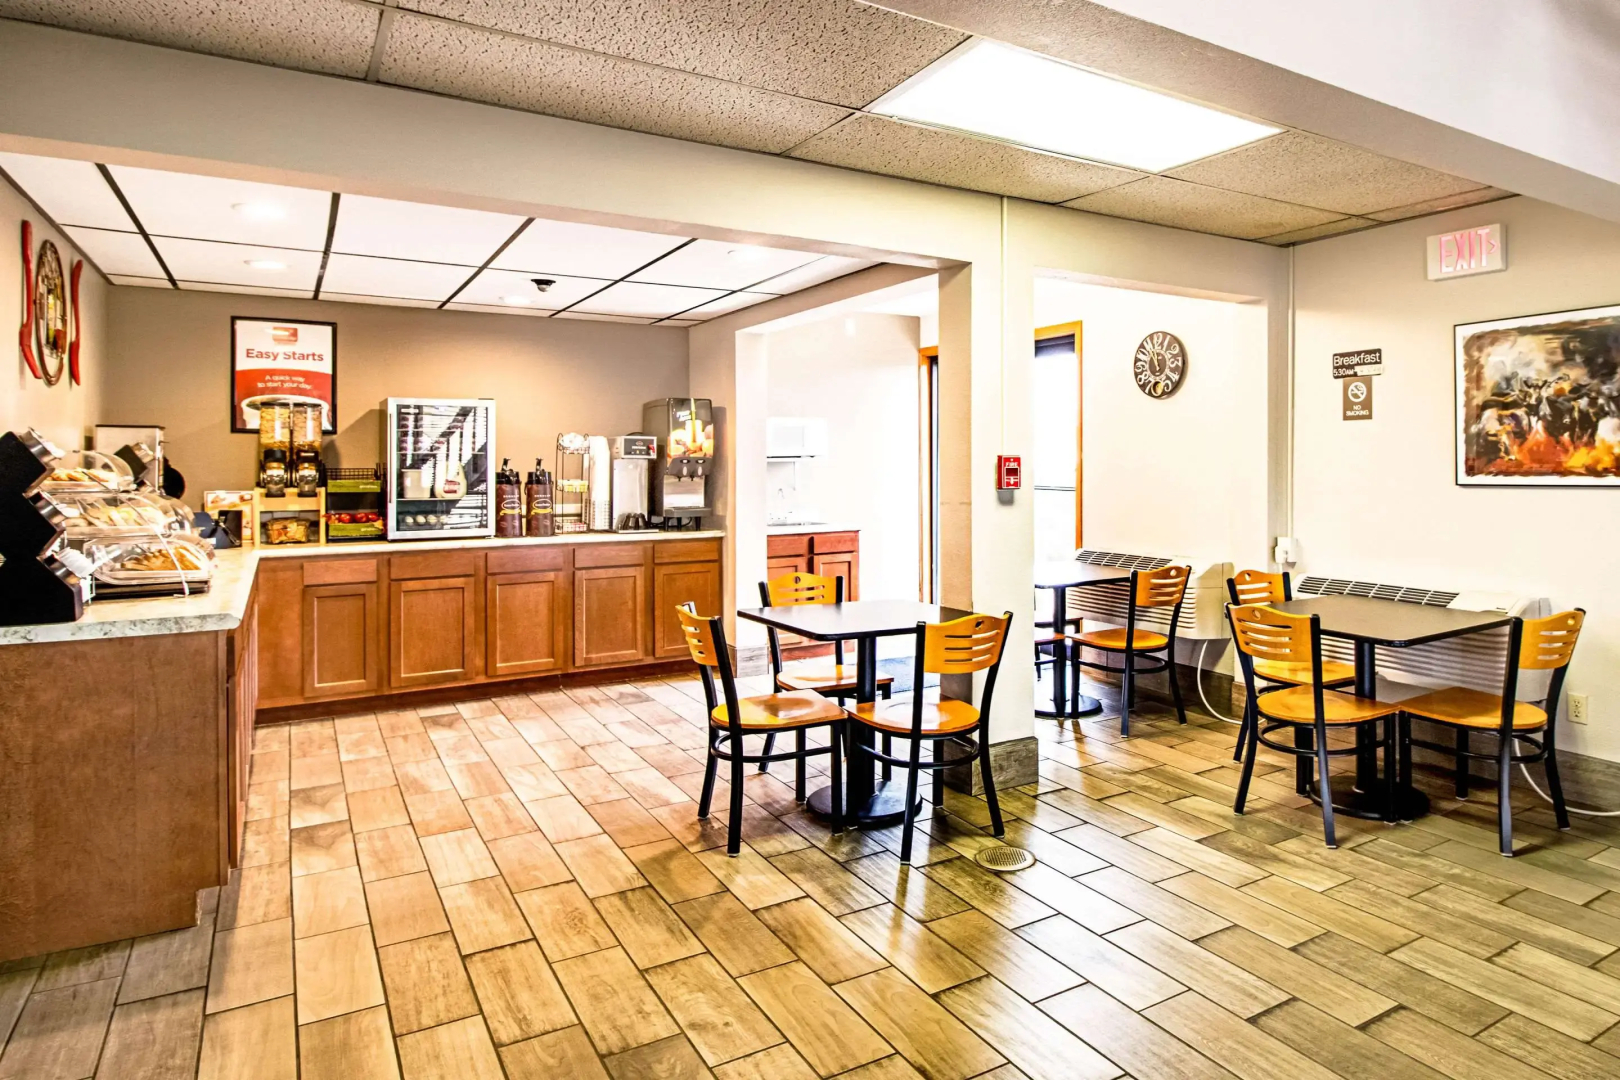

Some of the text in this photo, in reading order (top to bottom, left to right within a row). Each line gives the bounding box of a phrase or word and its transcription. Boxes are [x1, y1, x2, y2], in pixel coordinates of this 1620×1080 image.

[1440, 228, 1491, 273] EXIT
[245, 348, 325, 362] Easy Starts
[1333, 351, 1380, 367] Breakfast
